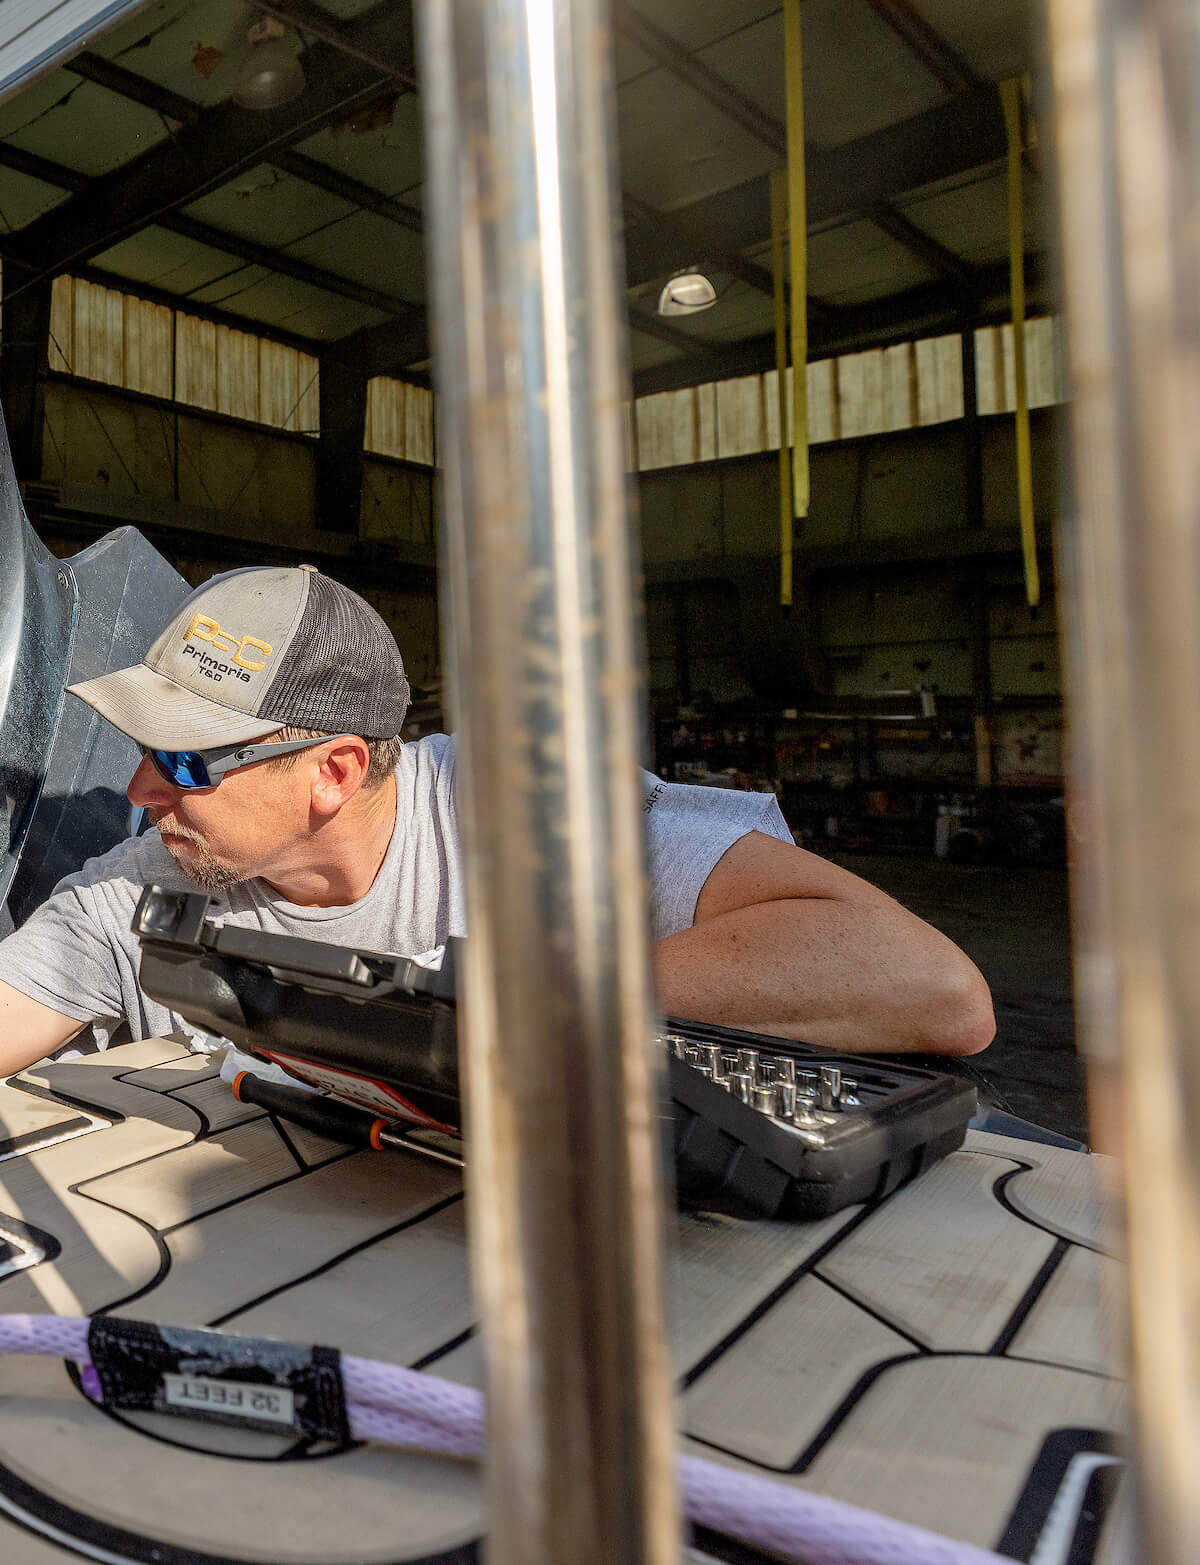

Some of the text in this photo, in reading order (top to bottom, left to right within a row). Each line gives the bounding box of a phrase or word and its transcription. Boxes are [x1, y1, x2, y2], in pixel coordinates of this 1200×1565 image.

[183, 645, 251, 682] Primoris
[198, 666, 222, 682] T&D
[179, 1382, 281, 1414] 32 FEET
